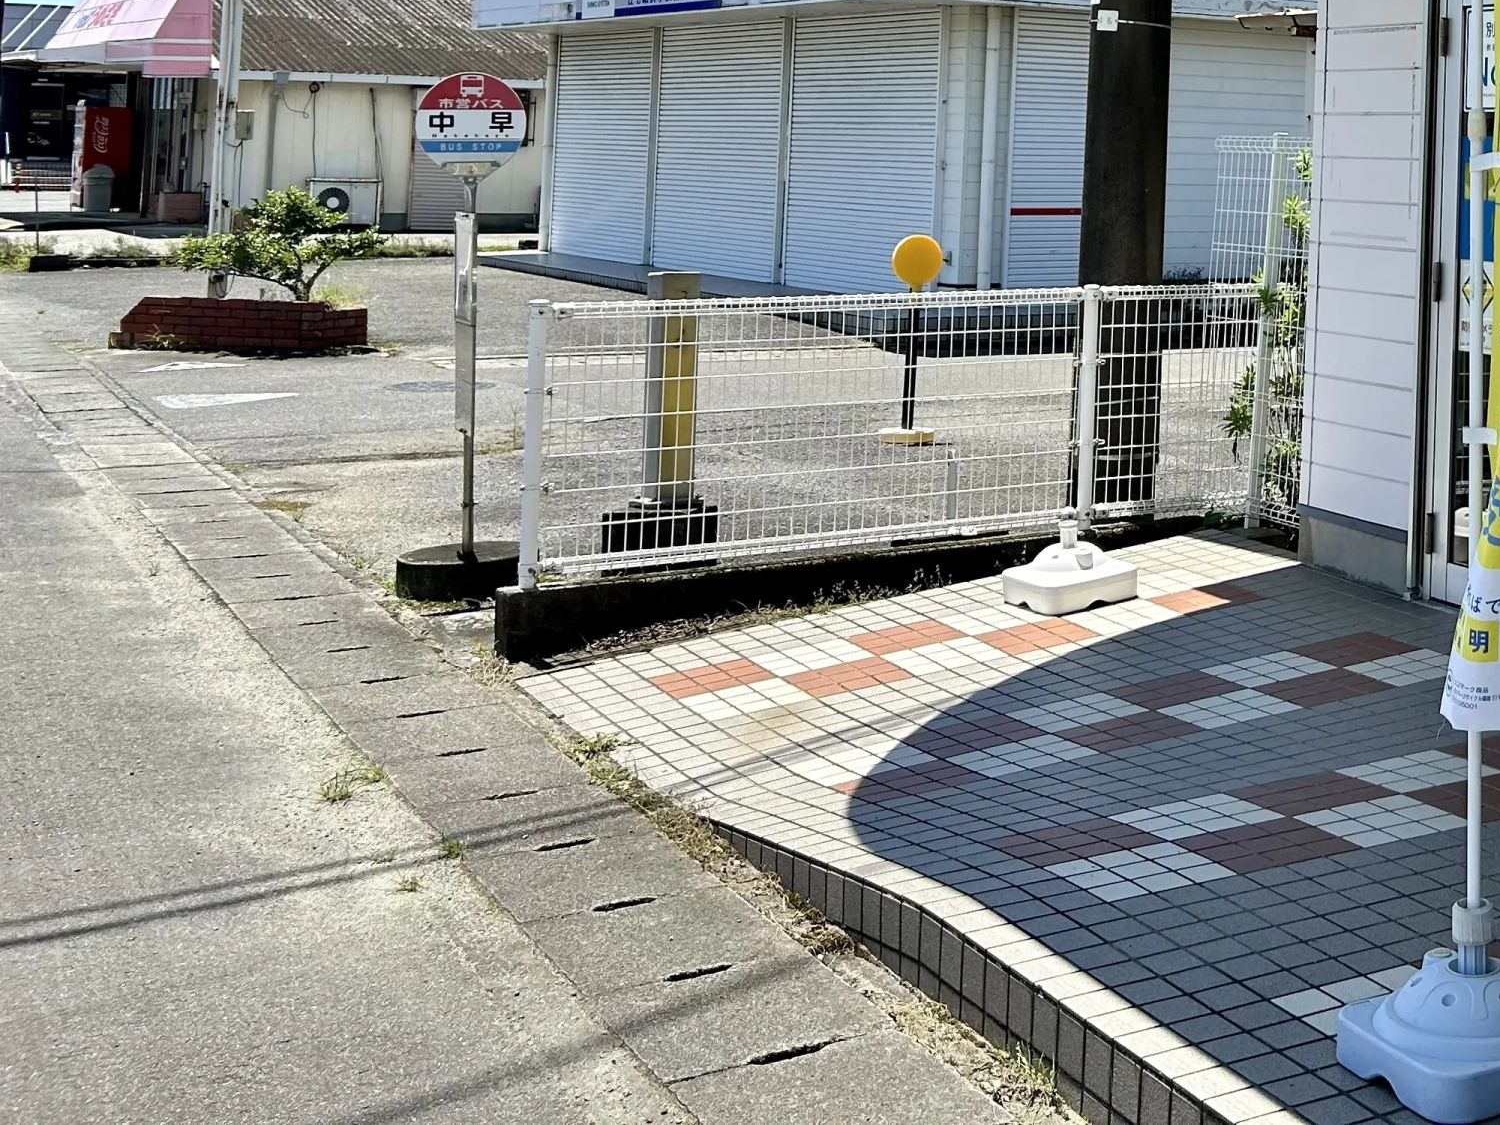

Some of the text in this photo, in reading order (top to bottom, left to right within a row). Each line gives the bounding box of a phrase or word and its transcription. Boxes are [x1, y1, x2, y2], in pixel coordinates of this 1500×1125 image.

[438, 97, 504, 109] 市営バス
[440, 142, 503, 151] BUS STOP
